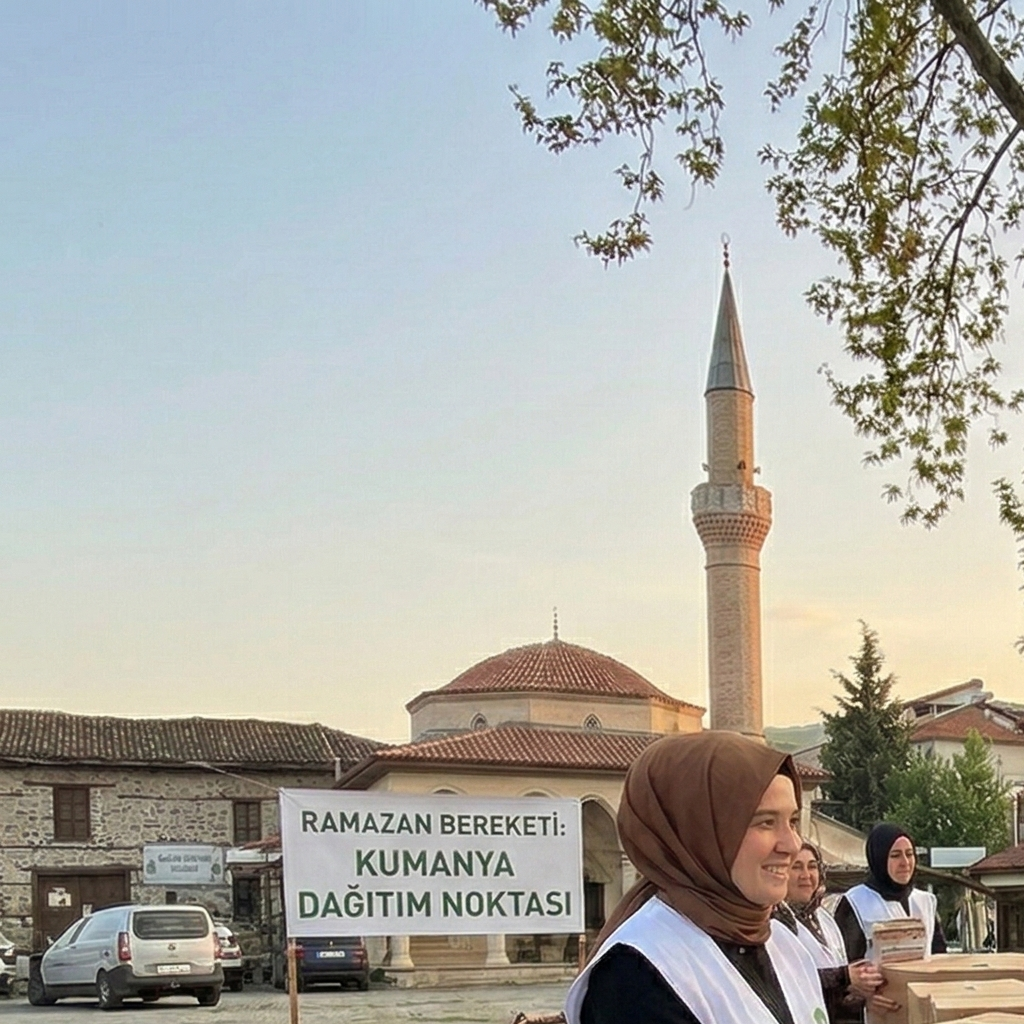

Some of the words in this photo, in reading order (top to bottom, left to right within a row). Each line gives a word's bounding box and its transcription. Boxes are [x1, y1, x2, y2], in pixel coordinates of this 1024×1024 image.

[301, 810, 432, 834] RAMAZAN
[440, 811, 566, 836] BEREKETİ:
[355, 849, 515, 877] KUMANYA
[299, 884, 431, 918] DAĞITIM
[442, 891, 571, 917] NOKTASI
